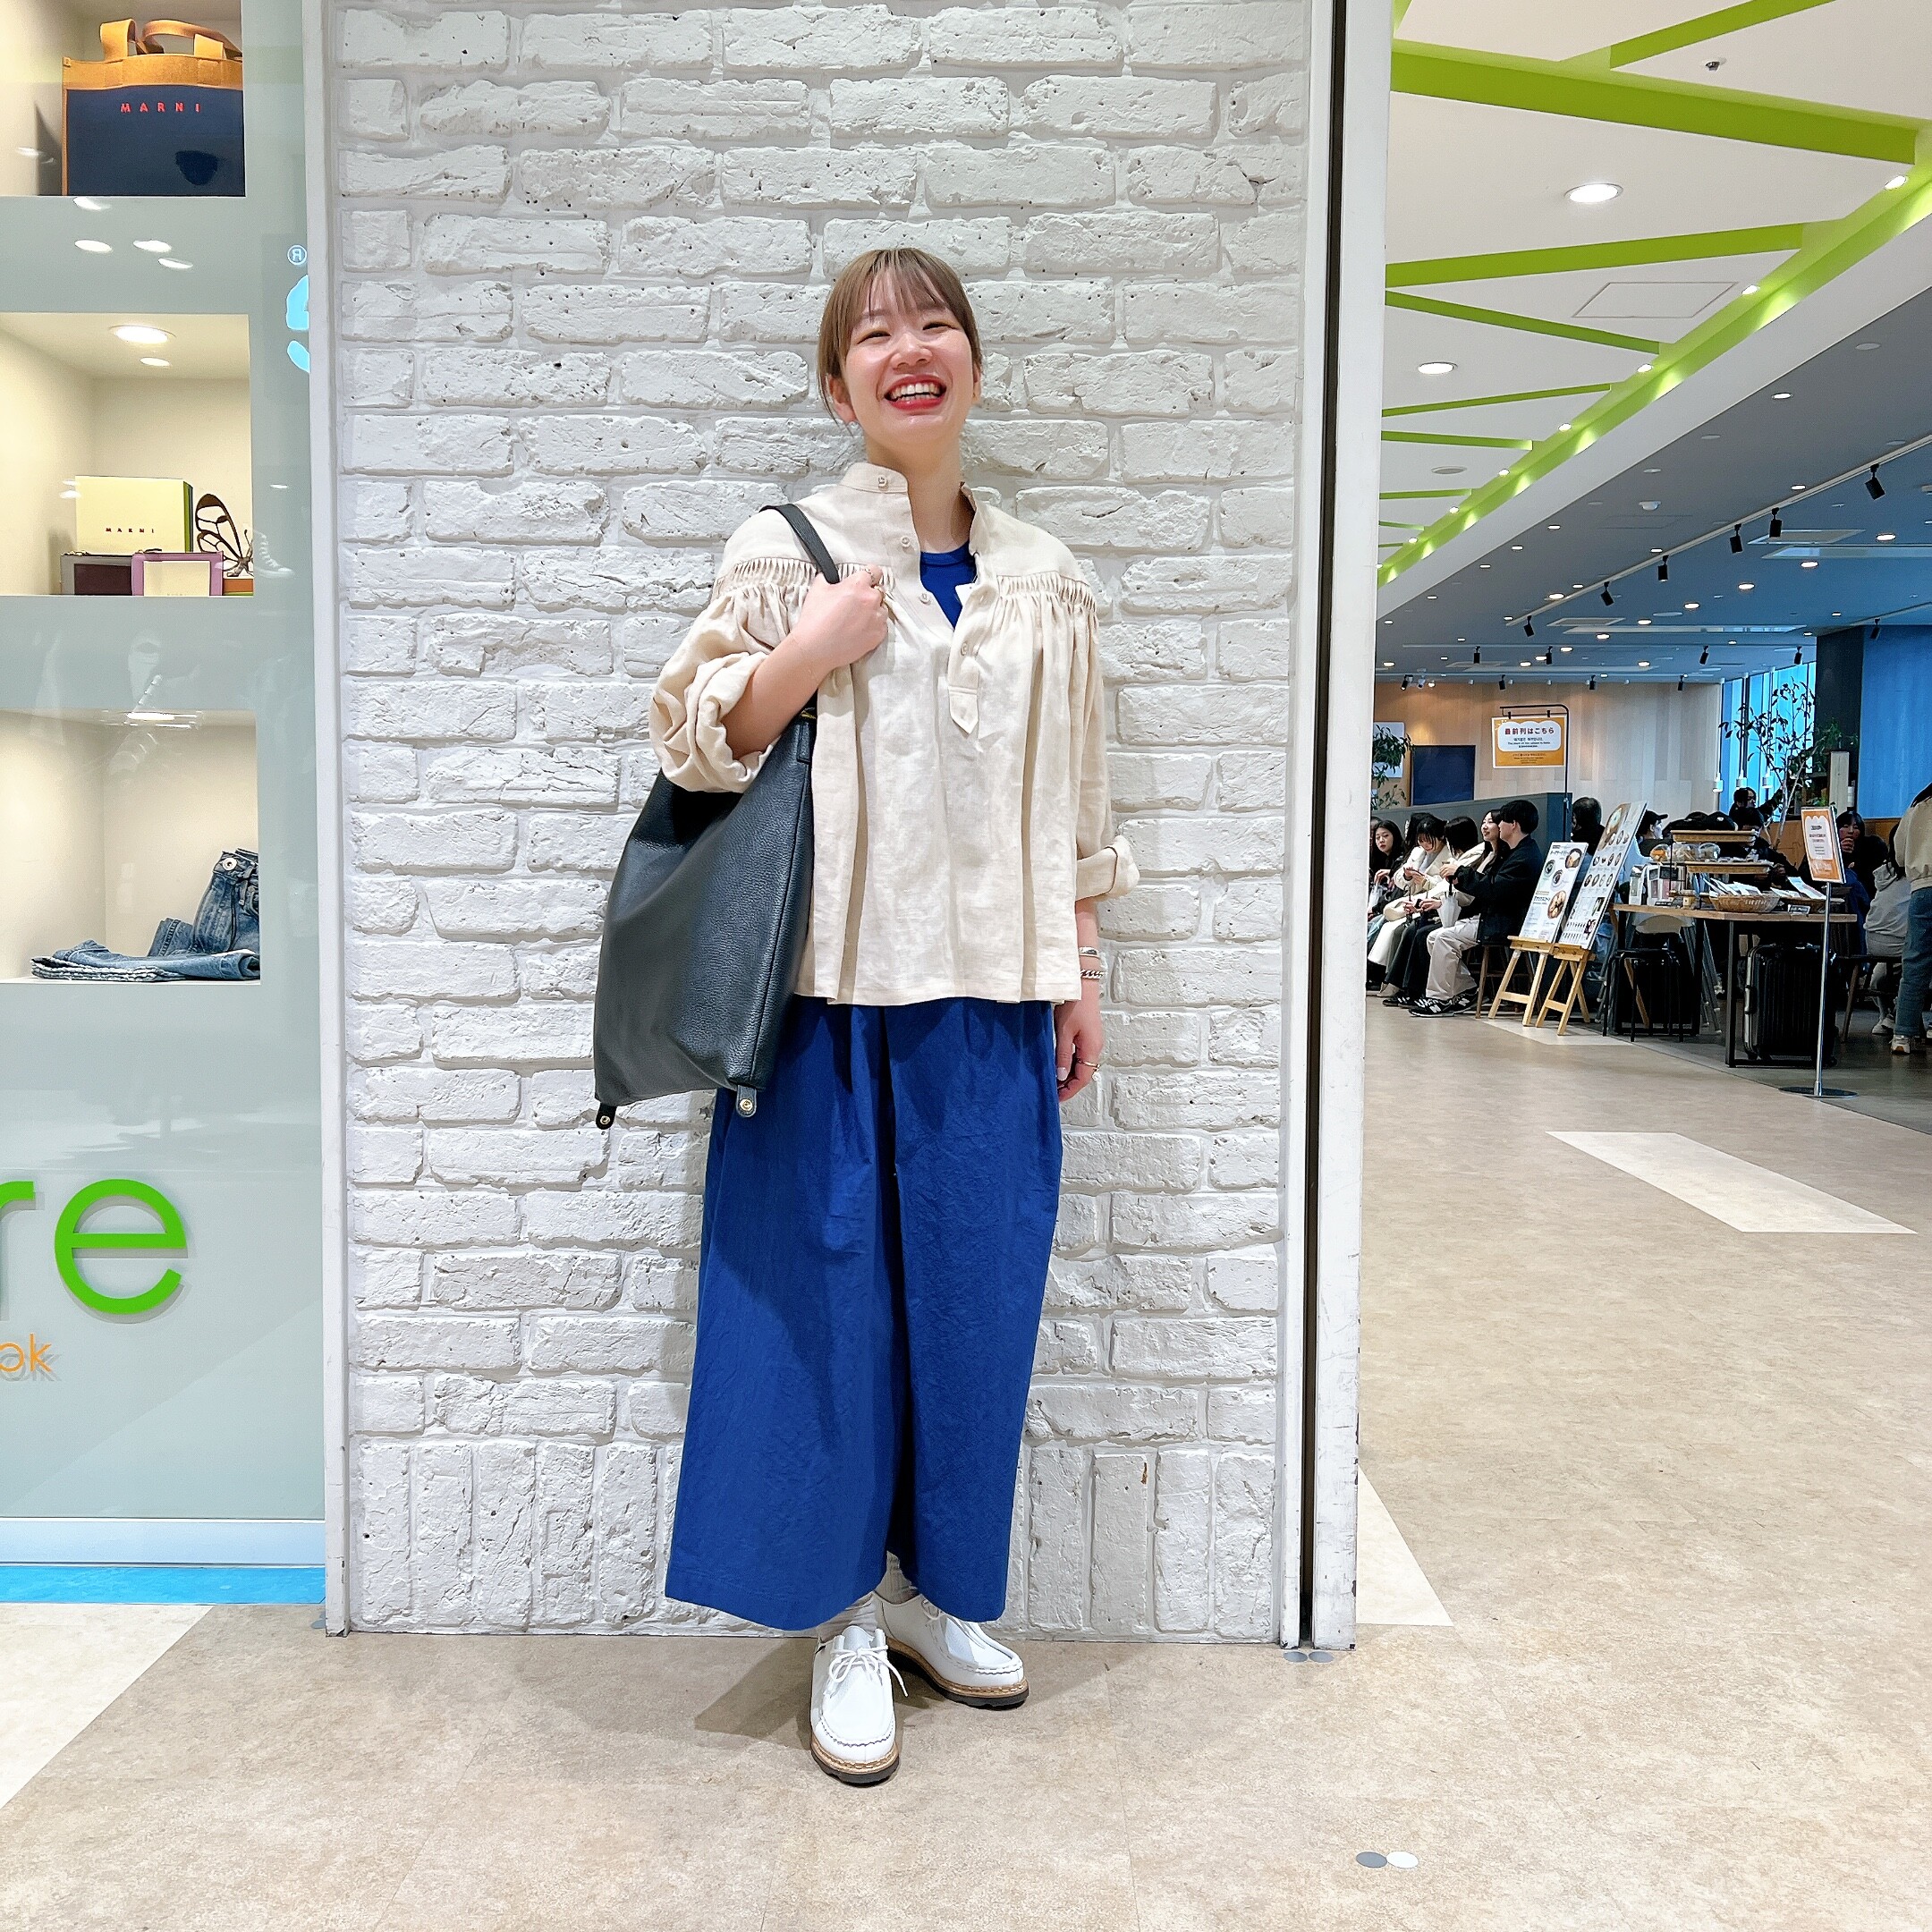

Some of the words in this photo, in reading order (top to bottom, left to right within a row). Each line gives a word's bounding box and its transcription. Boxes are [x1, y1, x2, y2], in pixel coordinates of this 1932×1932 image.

[120, 102, 200, 113] MARNI
[1504, 727, 1555, 735] 最前列はこちら
